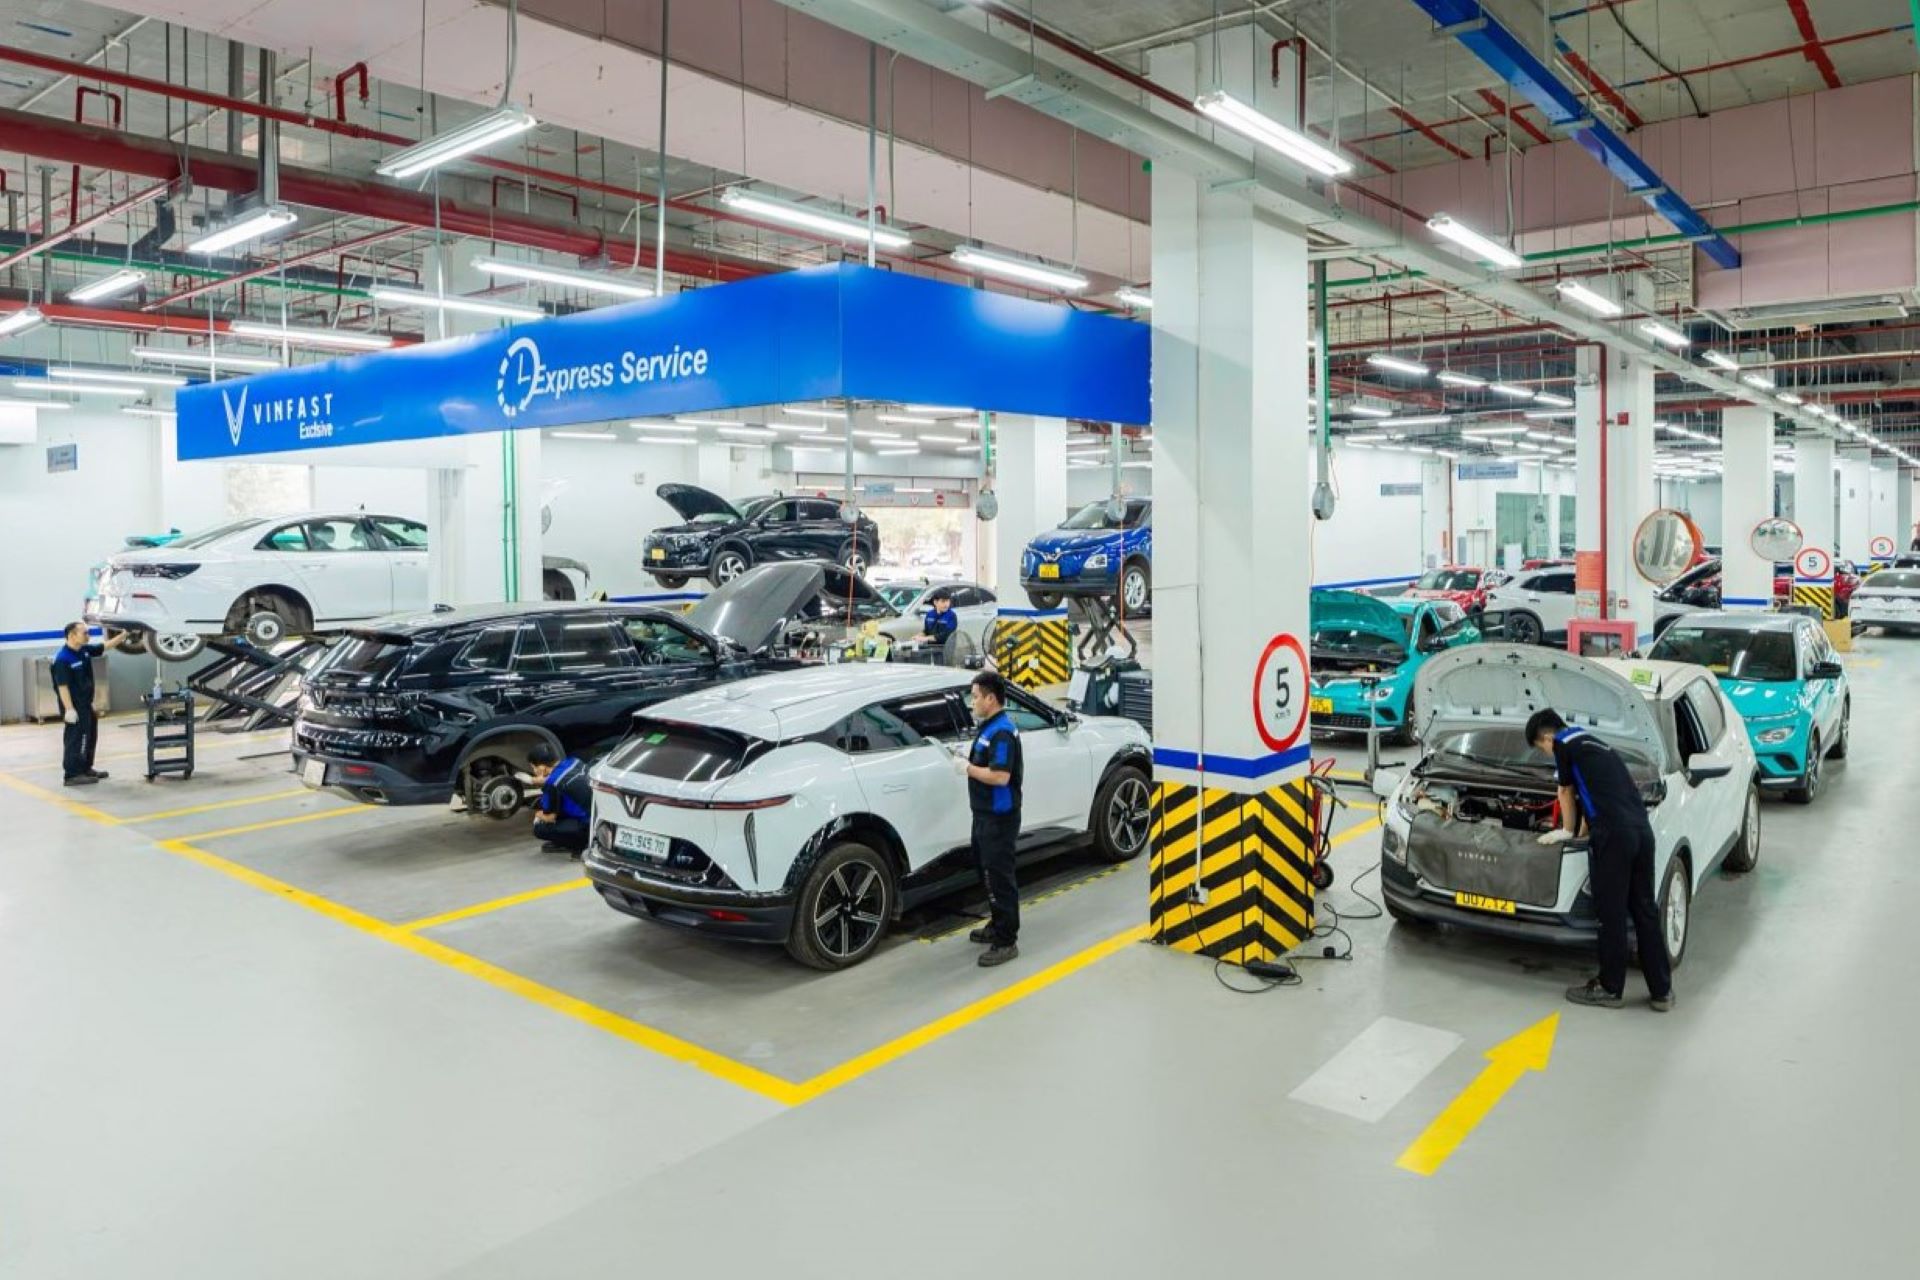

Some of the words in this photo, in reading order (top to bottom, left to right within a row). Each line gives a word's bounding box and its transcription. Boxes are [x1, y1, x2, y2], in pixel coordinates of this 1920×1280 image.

[531, 361, 614, 400] Express
[620, 344, 709, 384] Service
[253, 392, 333, 424] VINFAST
[1808, 556, 1818, 568] 5
[1275, 666, 1290, 708] 5
